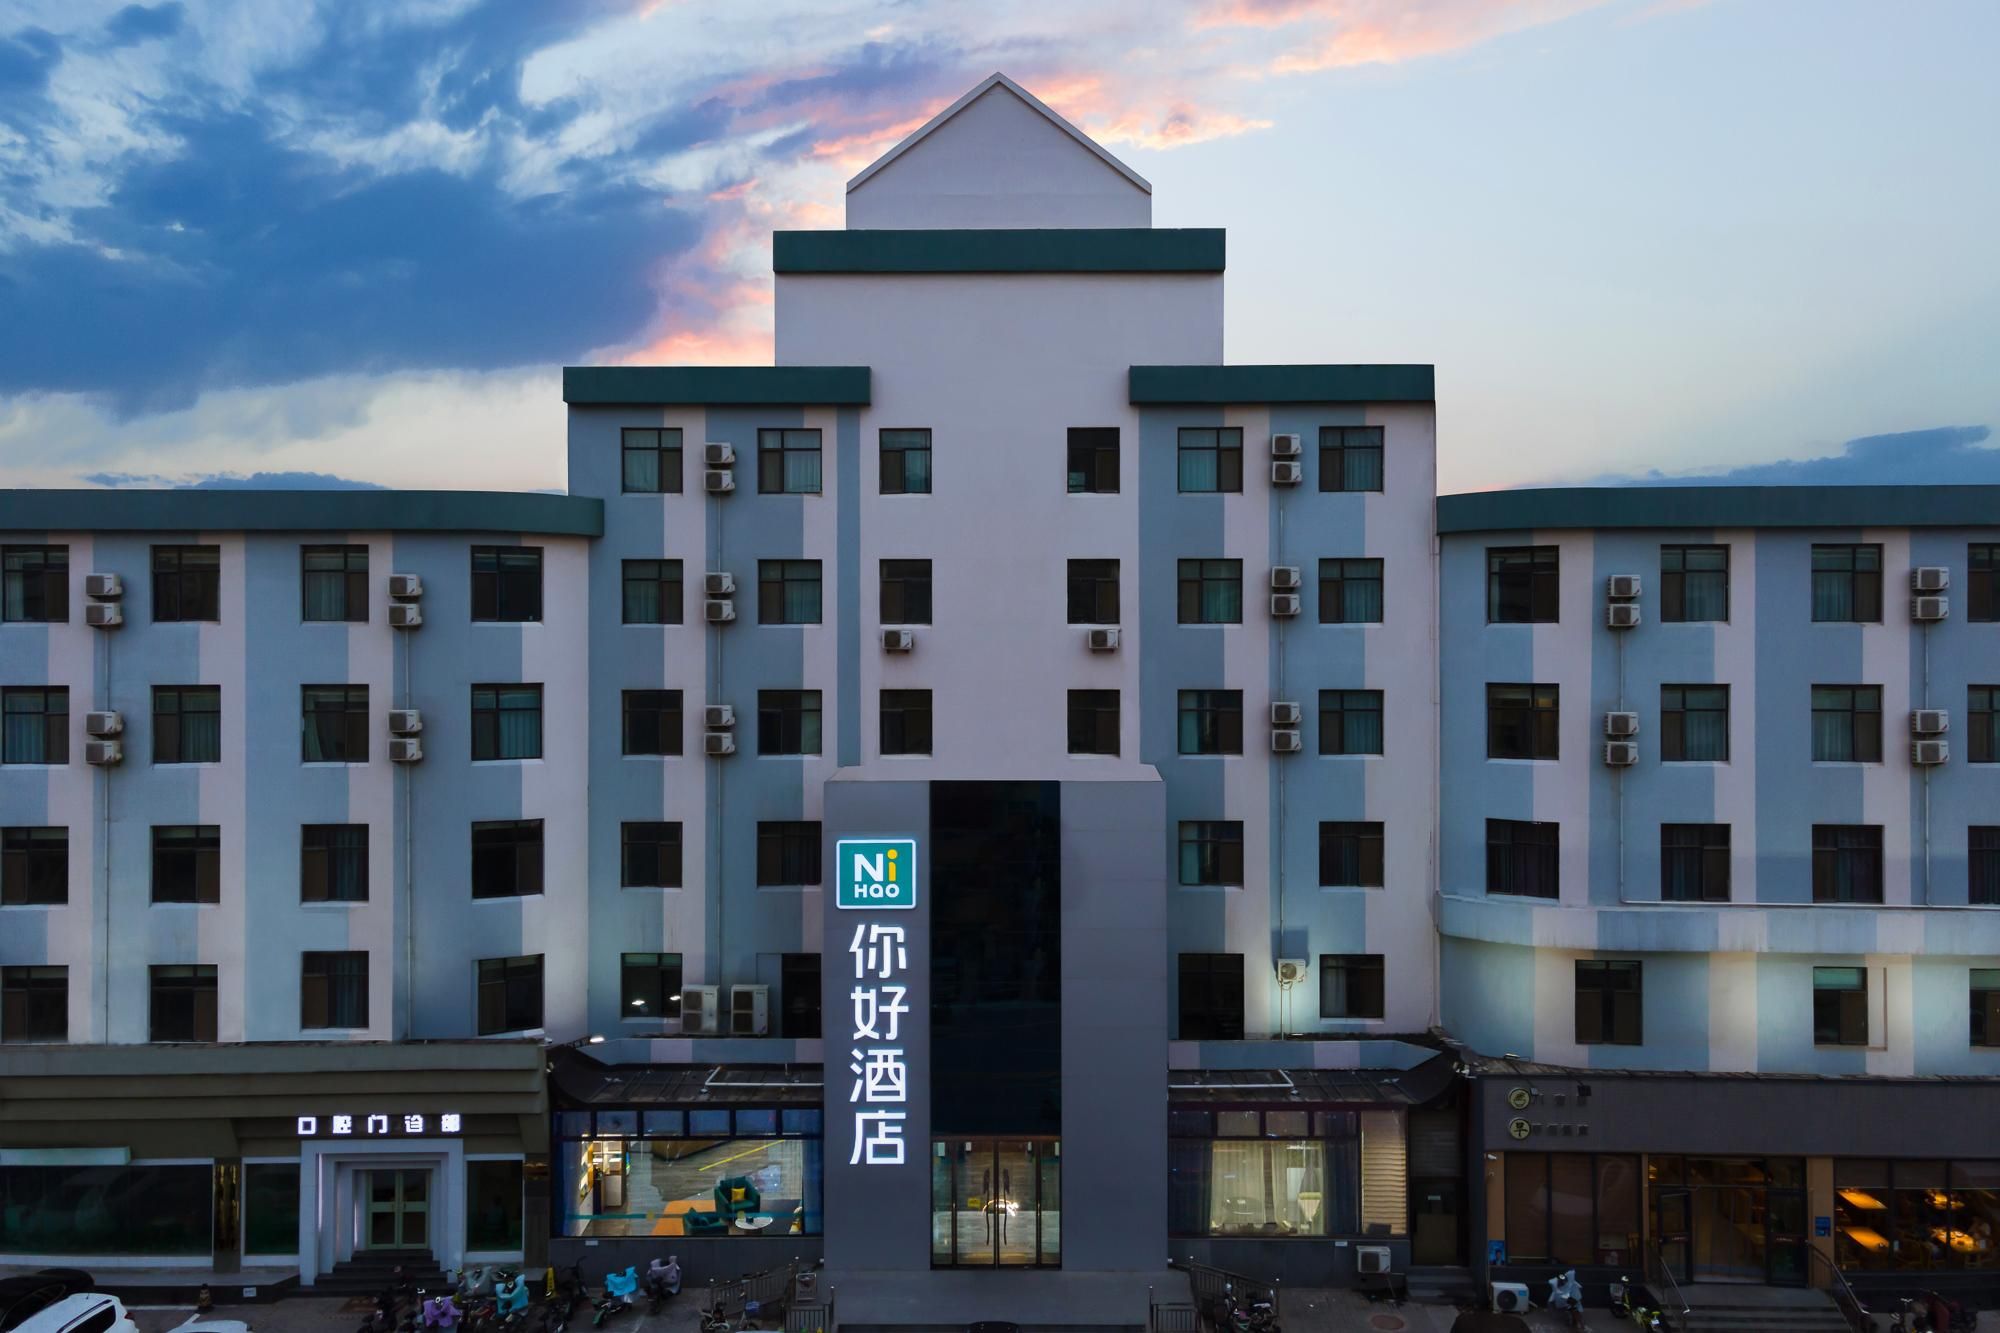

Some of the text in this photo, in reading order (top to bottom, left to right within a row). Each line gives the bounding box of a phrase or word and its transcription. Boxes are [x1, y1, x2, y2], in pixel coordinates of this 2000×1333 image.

[854, 849, 898, 882] Ni
[849, 923, 909, 1165] 你好酒店
